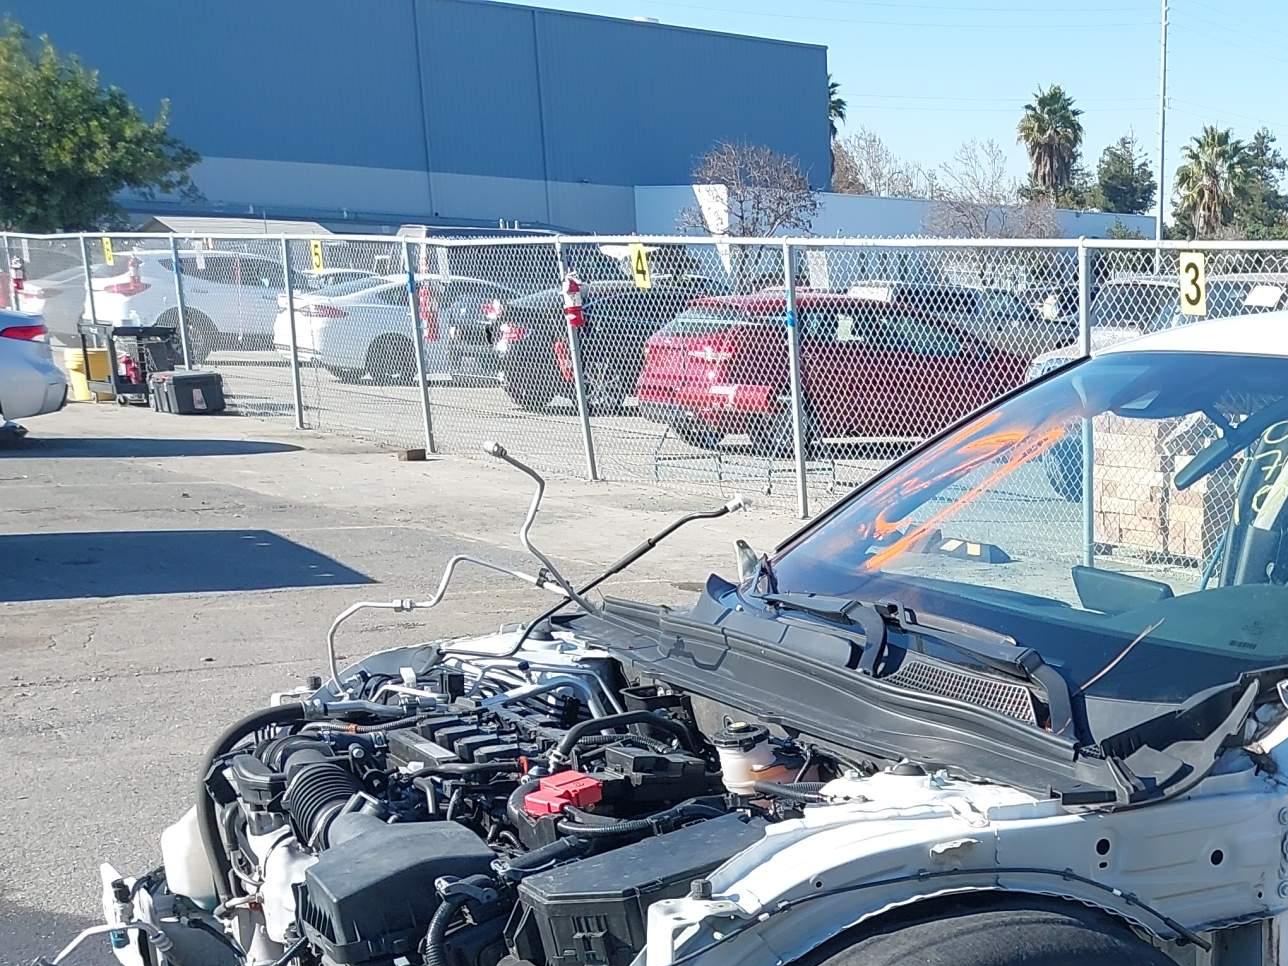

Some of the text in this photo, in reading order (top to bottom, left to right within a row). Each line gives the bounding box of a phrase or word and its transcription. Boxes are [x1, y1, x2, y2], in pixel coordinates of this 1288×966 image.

[313, 243, 321, 269] 5
[636, 249, 647, 282] 4
[1184, 262, 1202, 306] 3
